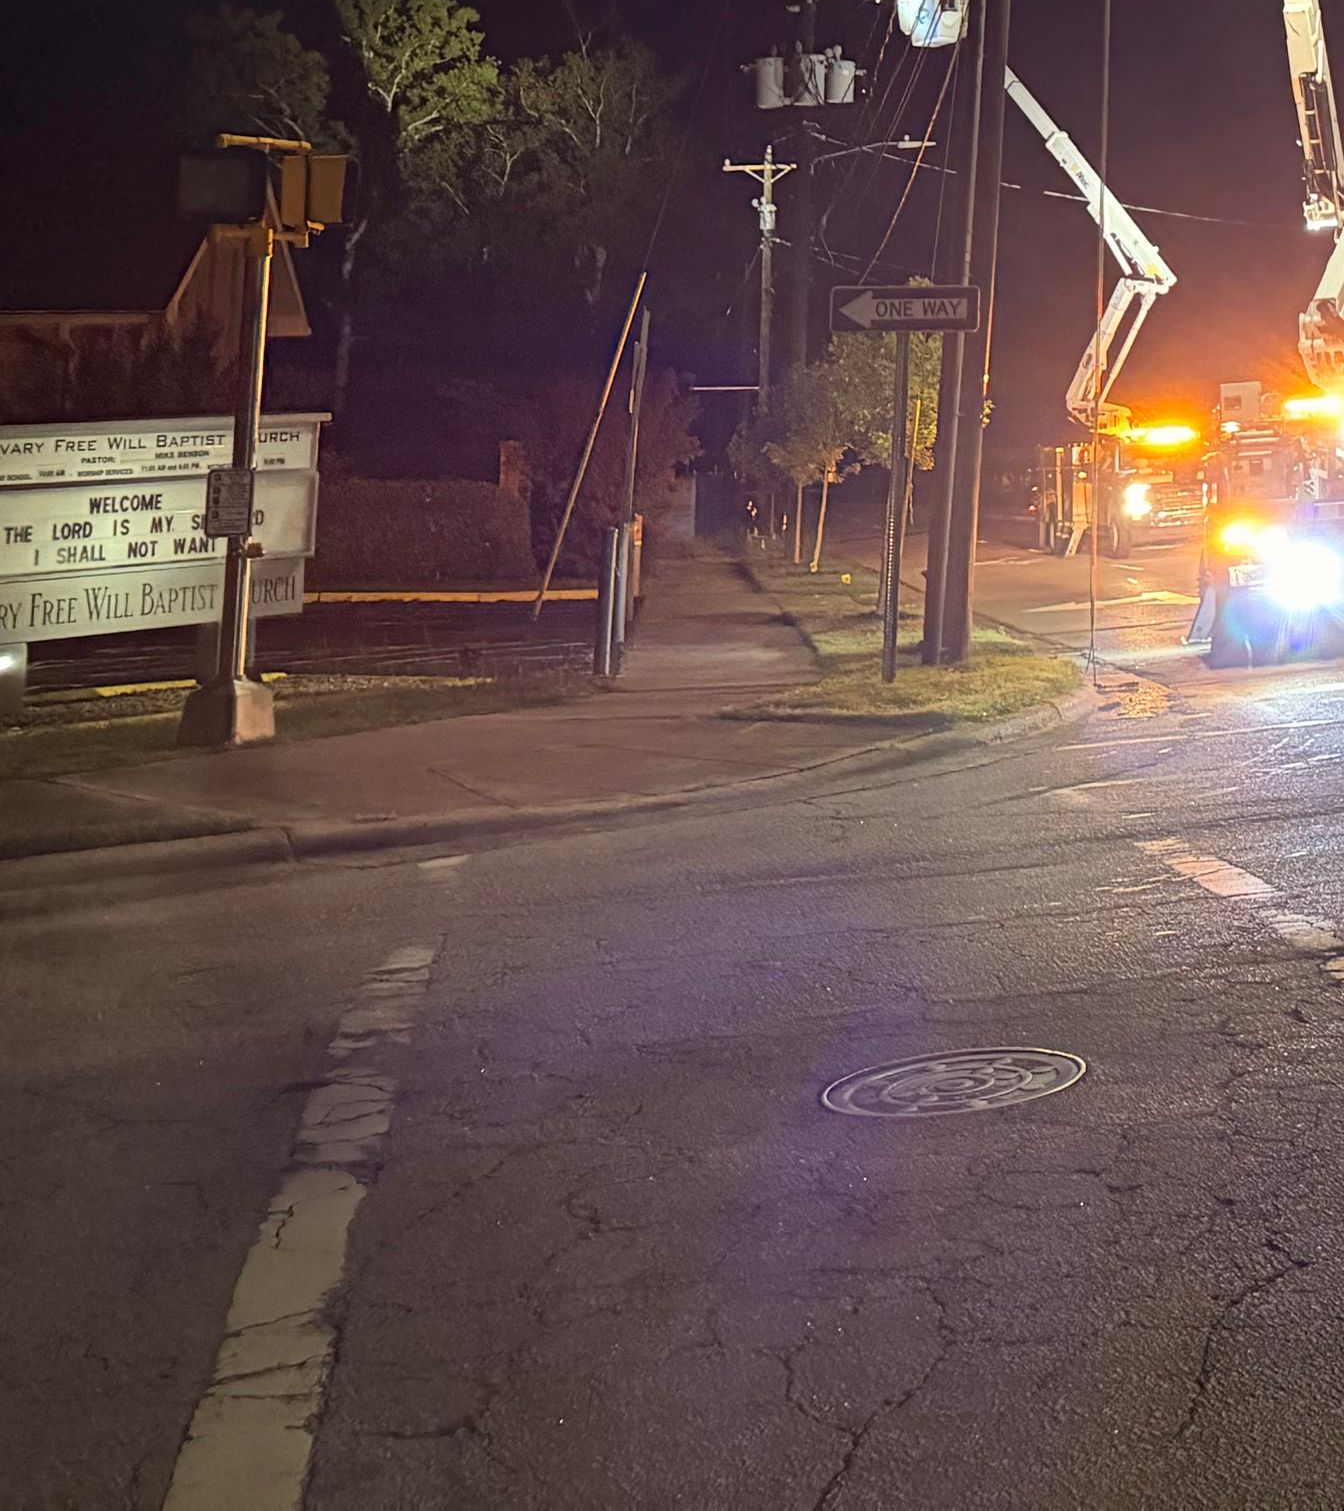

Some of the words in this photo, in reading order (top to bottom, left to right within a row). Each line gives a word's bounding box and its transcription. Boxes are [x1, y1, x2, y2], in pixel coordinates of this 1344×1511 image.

[875, 301, 914, 318] ONE
[922, 300, 962, 316] WAY
[55, 439, 97, 453] FREE
[107, 437, 147, 450] WILL
[156, 434, 226, 448] BAPTIST
[258, 431, 300, 443] URCH
[89, 494, 163, 514] WELCOME
[4, 526, 33, 544] THE
[52, 522, 93, 541] LORD
[113, 519, 130, 536] IS
[34, 550, 39, 566] I
[56, 545, 106, 564] SHALL
[128, 541, 158, 558] NOT
[174, 537, 217, 555] WANT
[29, 592, 78, 627] FREE
[84, 586, 134, 621] WILL
[140, 582, 219, 616] BAPTIST
[252, 575, 296, 604] URCH
